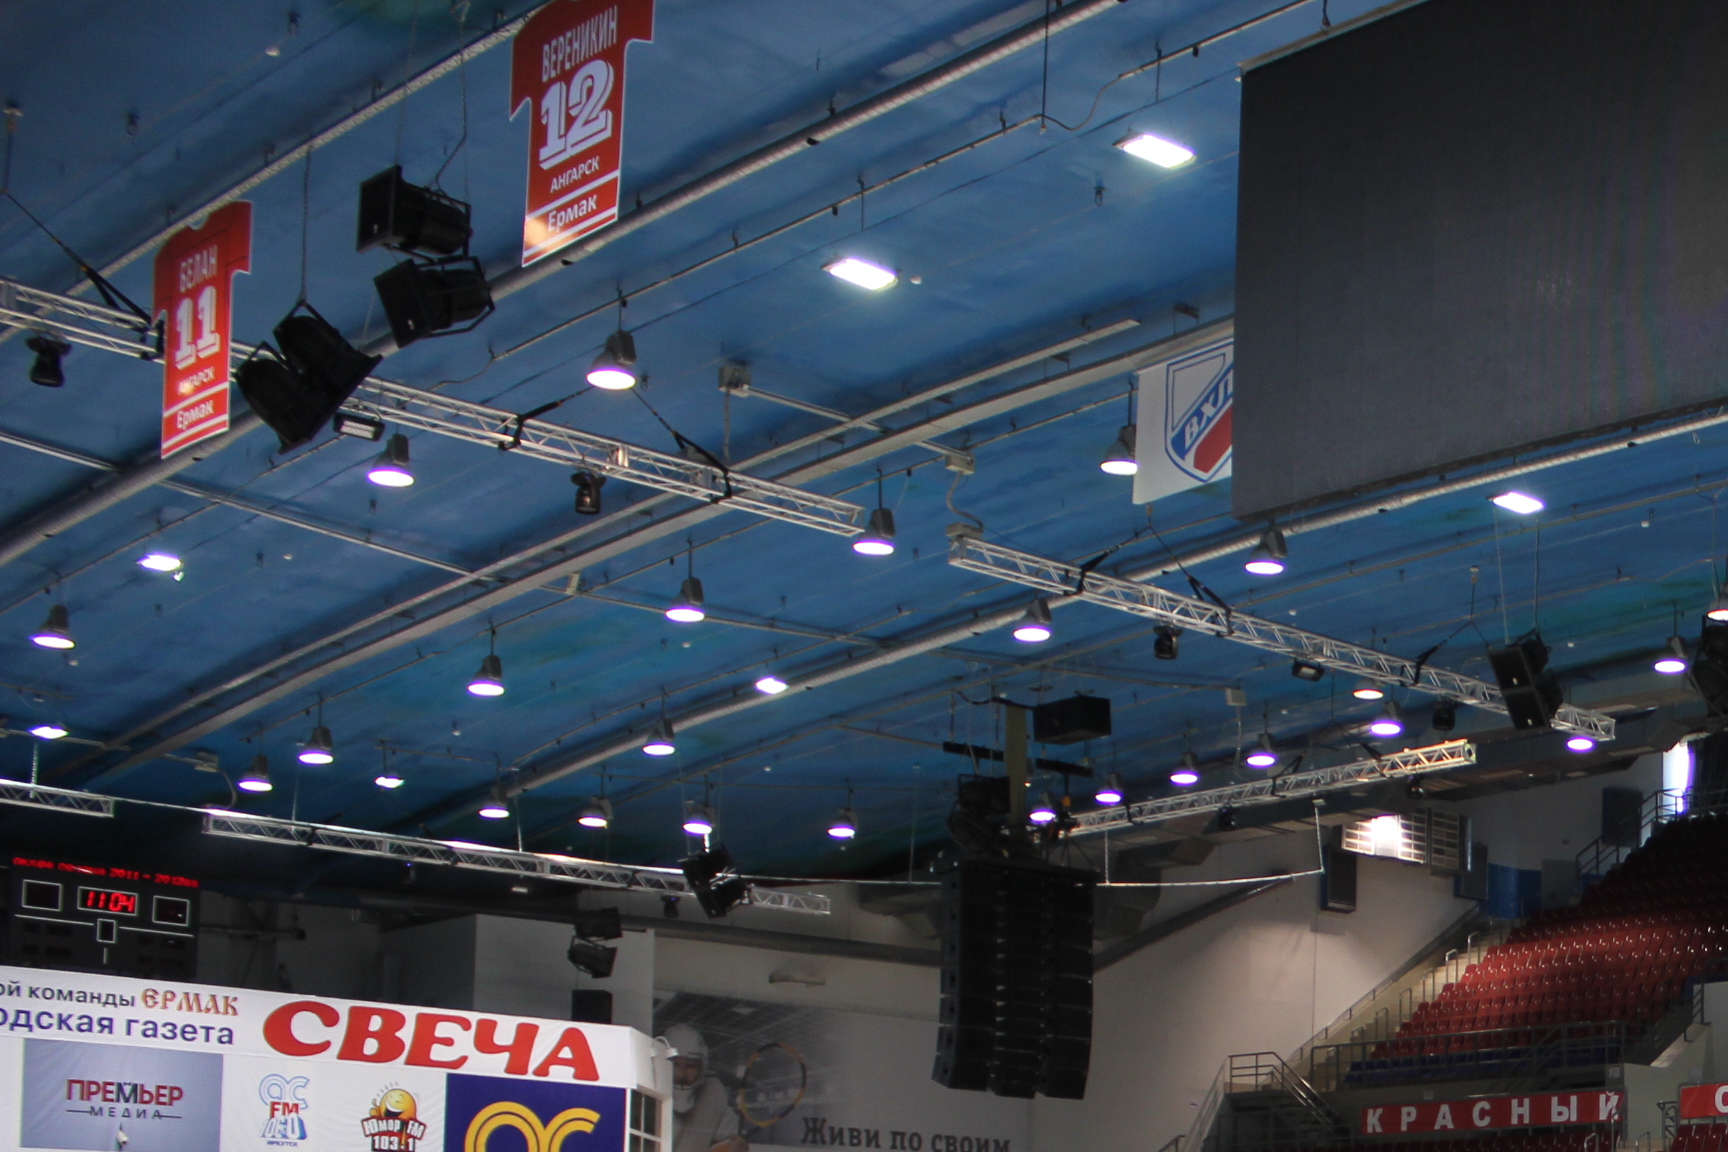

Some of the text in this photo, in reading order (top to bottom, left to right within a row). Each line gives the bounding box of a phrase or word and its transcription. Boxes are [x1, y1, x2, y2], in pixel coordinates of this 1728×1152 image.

[541, 5, 618, 83] ВЕРЕНИКИН
[539, 59, 614, 170] 12
[550, 156, 600, 193] АНГАРСК
[548, 194, 598, 232] Ермак
[175, 286, 220, 370] 11
[176, 400, 214, 430] Ермак
[28, 984, 135, 1009] команды
[125, 1018, 234, 1045] газета
[263, 1000, 600, 1081] СВЕЧА
[66, 1079, 184, 1106] ПРЕМЬЕР
[1366, 1090, 1622, 1134] КРАСНЫЙ
[801, 1116, 881, 1150] Живи
[889, 1129, 923, 1152] по
